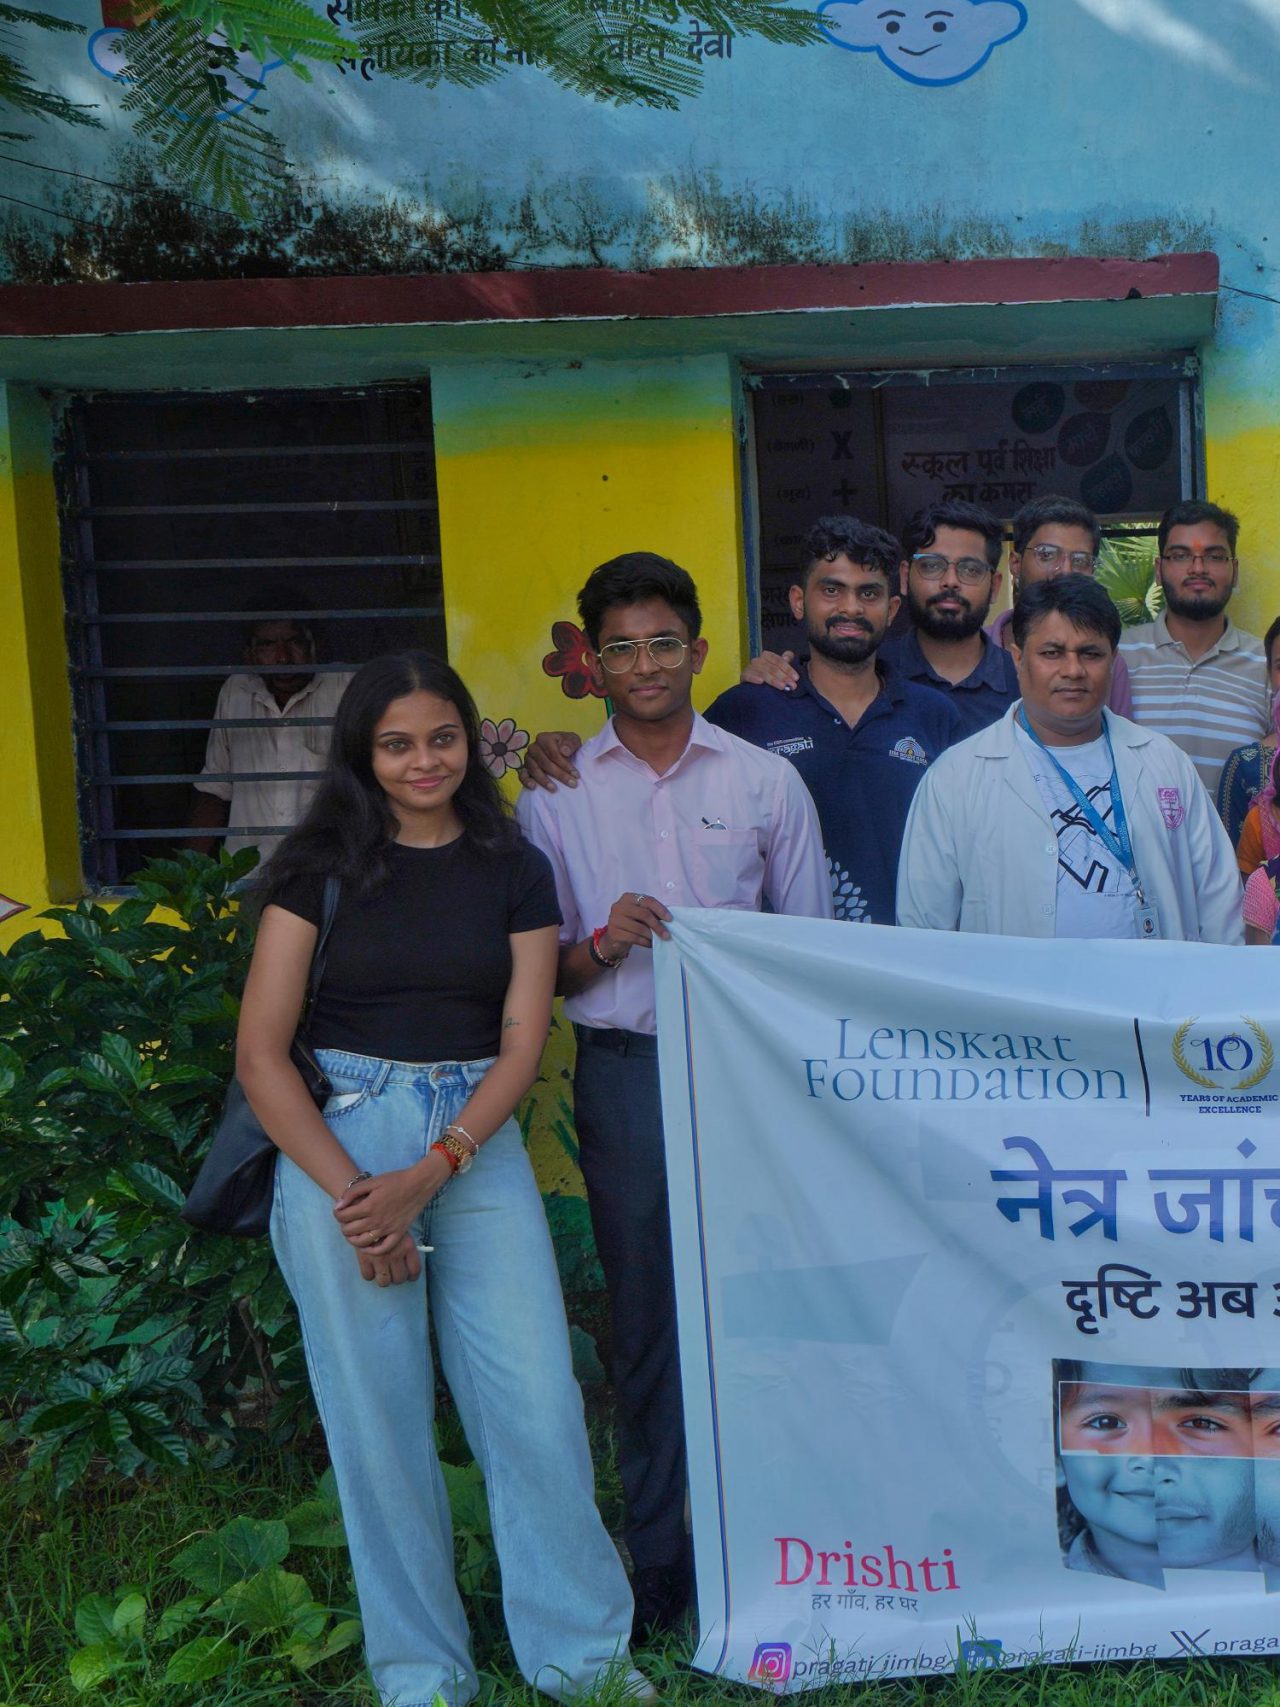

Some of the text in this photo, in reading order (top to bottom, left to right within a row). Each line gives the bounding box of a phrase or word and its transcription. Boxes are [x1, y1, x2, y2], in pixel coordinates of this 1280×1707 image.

[901, 452, 970, 481] स्कूल
[976, 439, 1009, 478] पूर्व
[1190, 1033, 1254, 1072] 10
[1179, 1094, 1211, 1102] YEARS
[1226, 1094, 1279, 1103] ACADEMIC
[1198, 1105, 1262, 1114] EXCELLENCE
[990, 1135, 1128, 1242] नेत्र
[1061, 1263, 1162, 1335] दृष्टि
[1176, 1278, 1259, 1319] अब
[774, 1537, 961, 1592] Drishti
[811, 1588, 919, 1613] हर गाँव, हर घर
